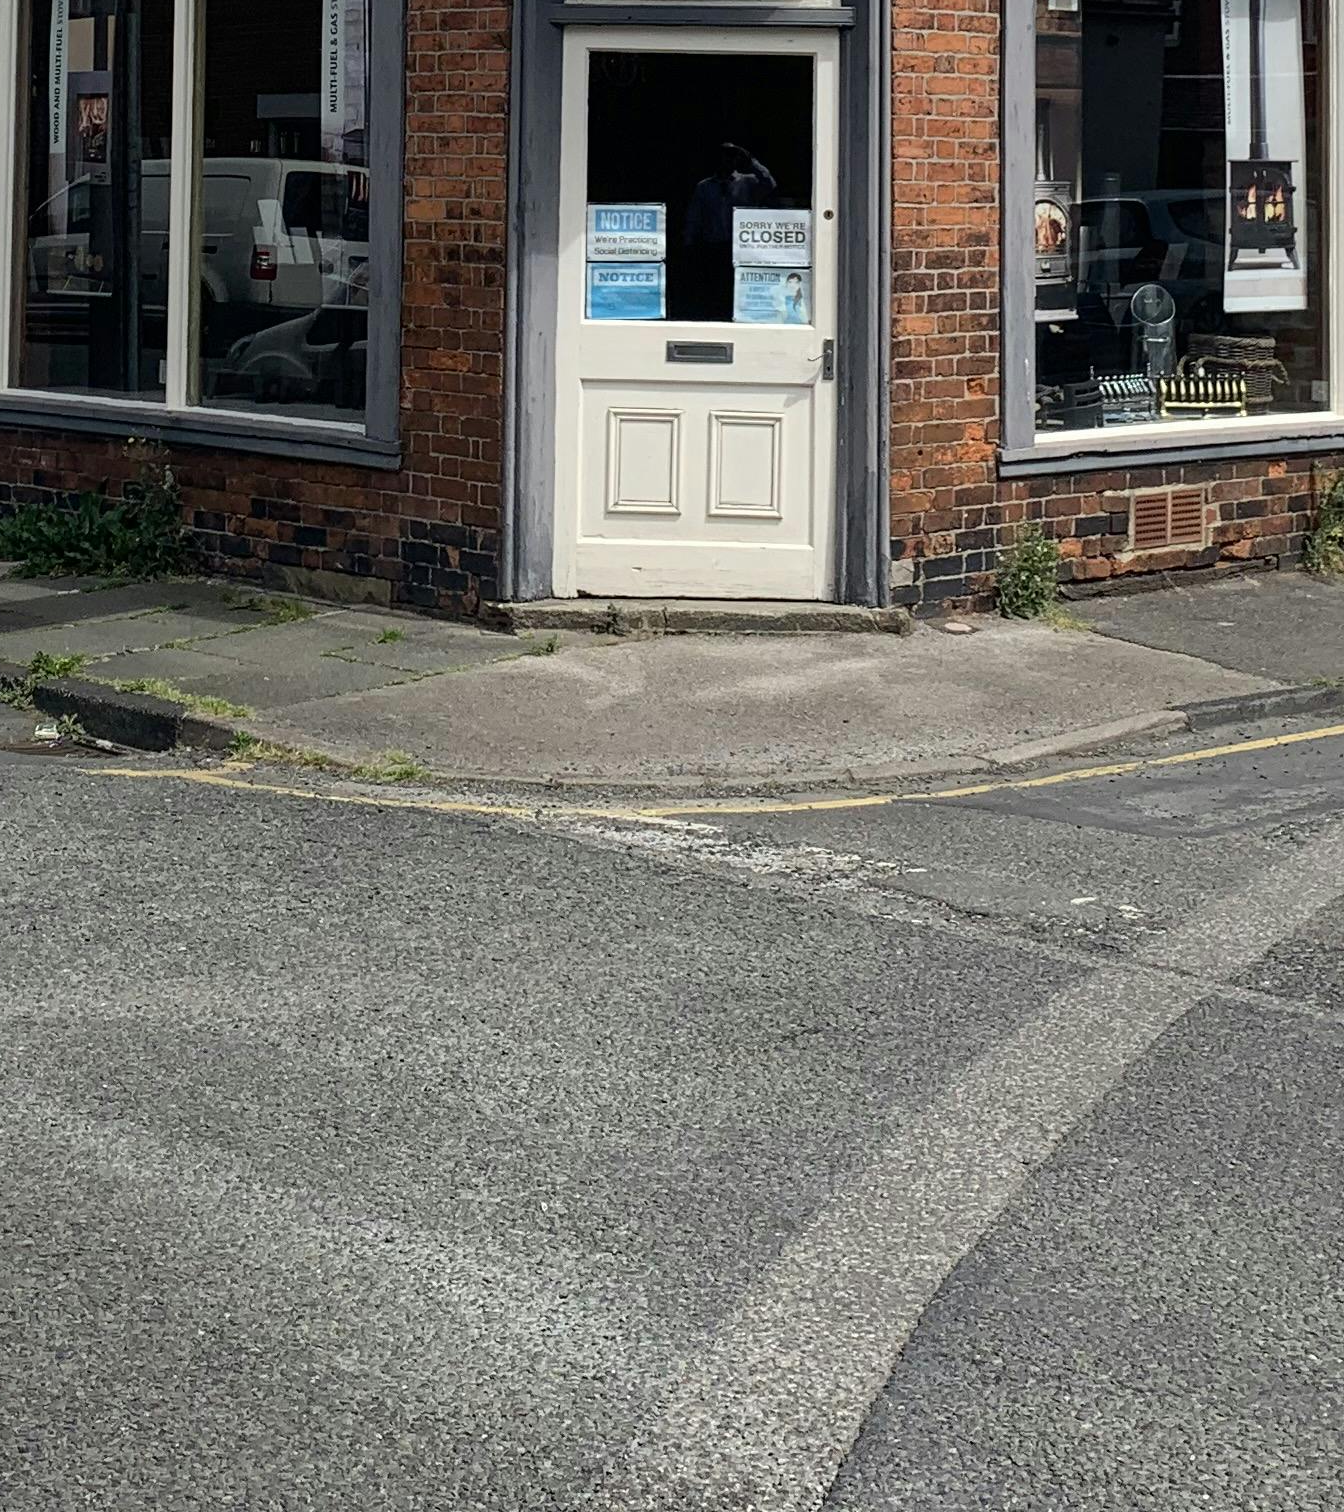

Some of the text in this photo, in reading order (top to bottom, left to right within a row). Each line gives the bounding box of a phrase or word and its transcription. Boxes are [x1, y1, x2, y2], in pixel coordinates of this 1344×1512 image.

[330, 13, 338, 34] GAS
[55, 27, 63, 84] MULTI-FUEL
[330, 51, 338, 113] MULTI-FUEL
[600, 212, 651, 230] NOTICE
[739, 231, 806, 243] CLOSED
[598, 273, 653, 282] NOTICE
[740, 272, 780, 282] ATTENTION
